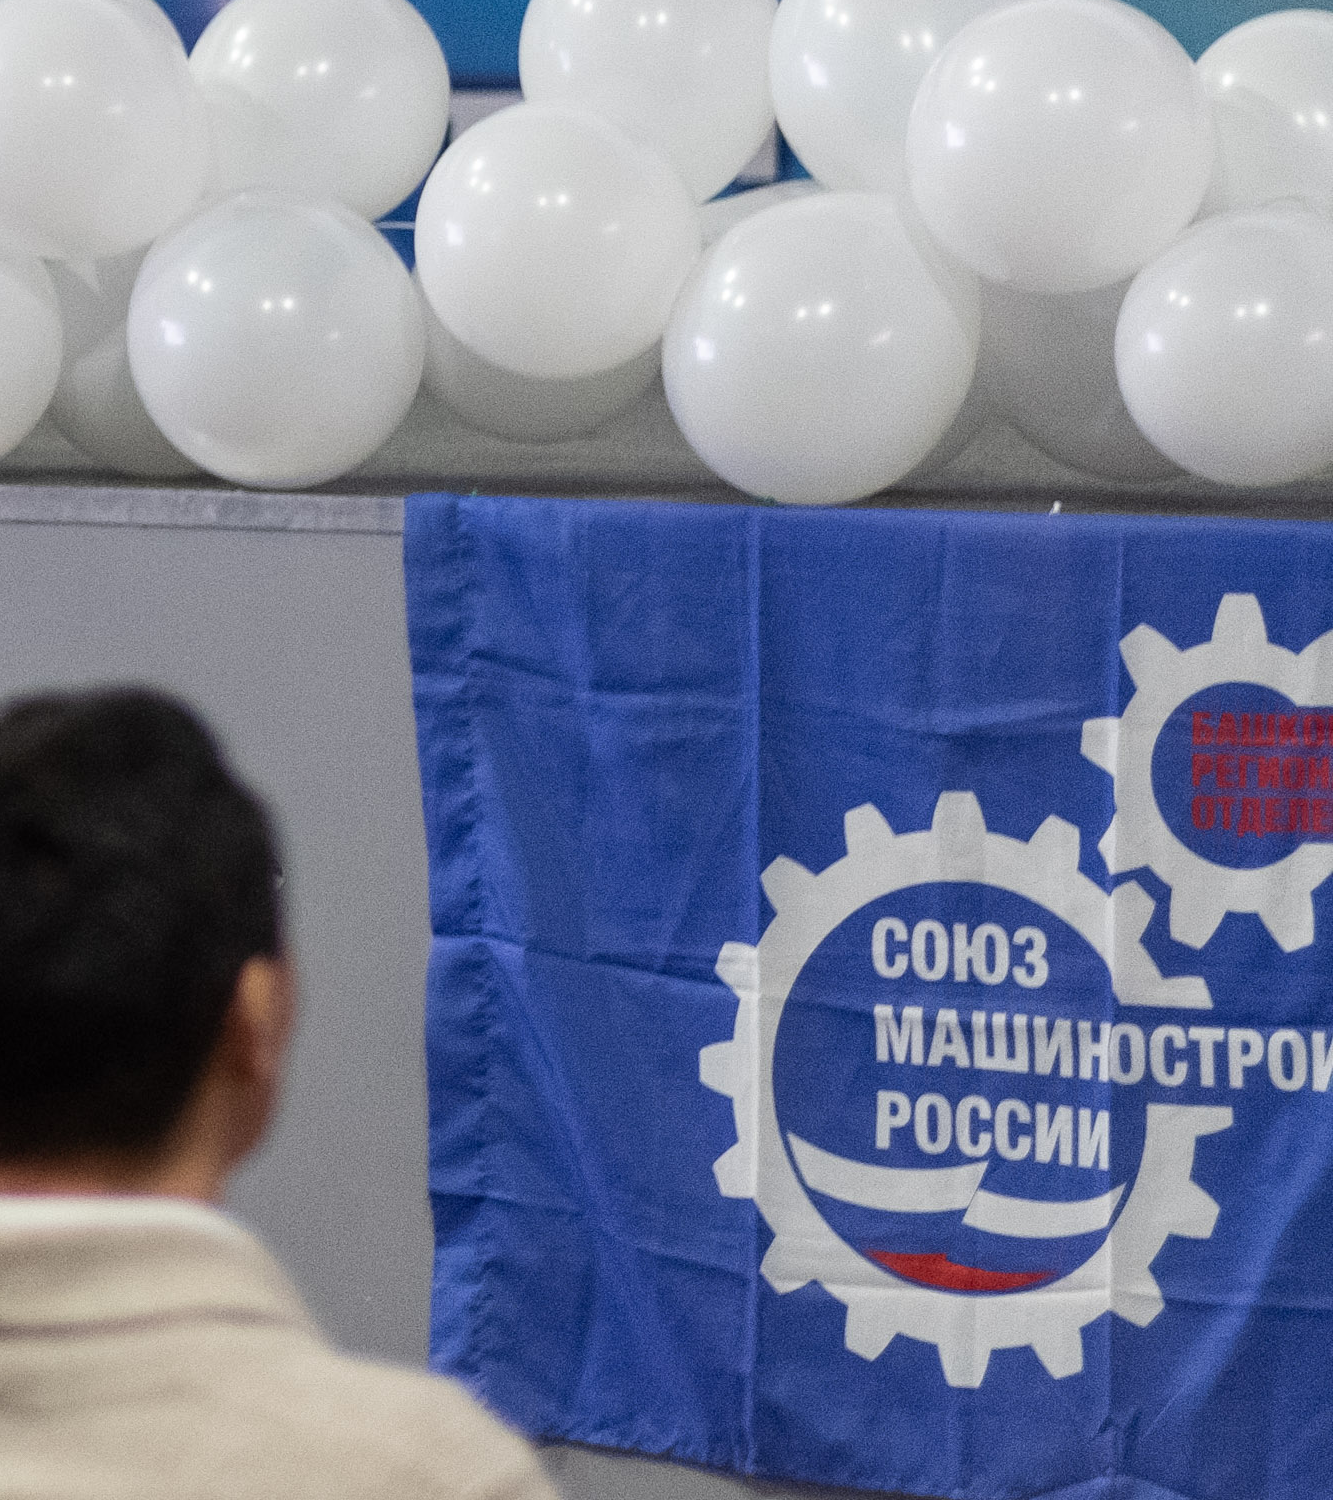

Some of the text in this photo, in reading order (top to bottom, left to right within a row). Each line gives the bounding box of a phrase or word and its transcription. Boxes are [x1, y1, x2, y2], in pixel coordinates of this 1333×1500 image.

[1192, 711, 1333, 748] БАШКО
[1192, 753, 1333, 790] РЕГИОН
[871, 916, 1049, 989] СОЮЗ
[875, 1089, 1110, 1172] РОССИИ
